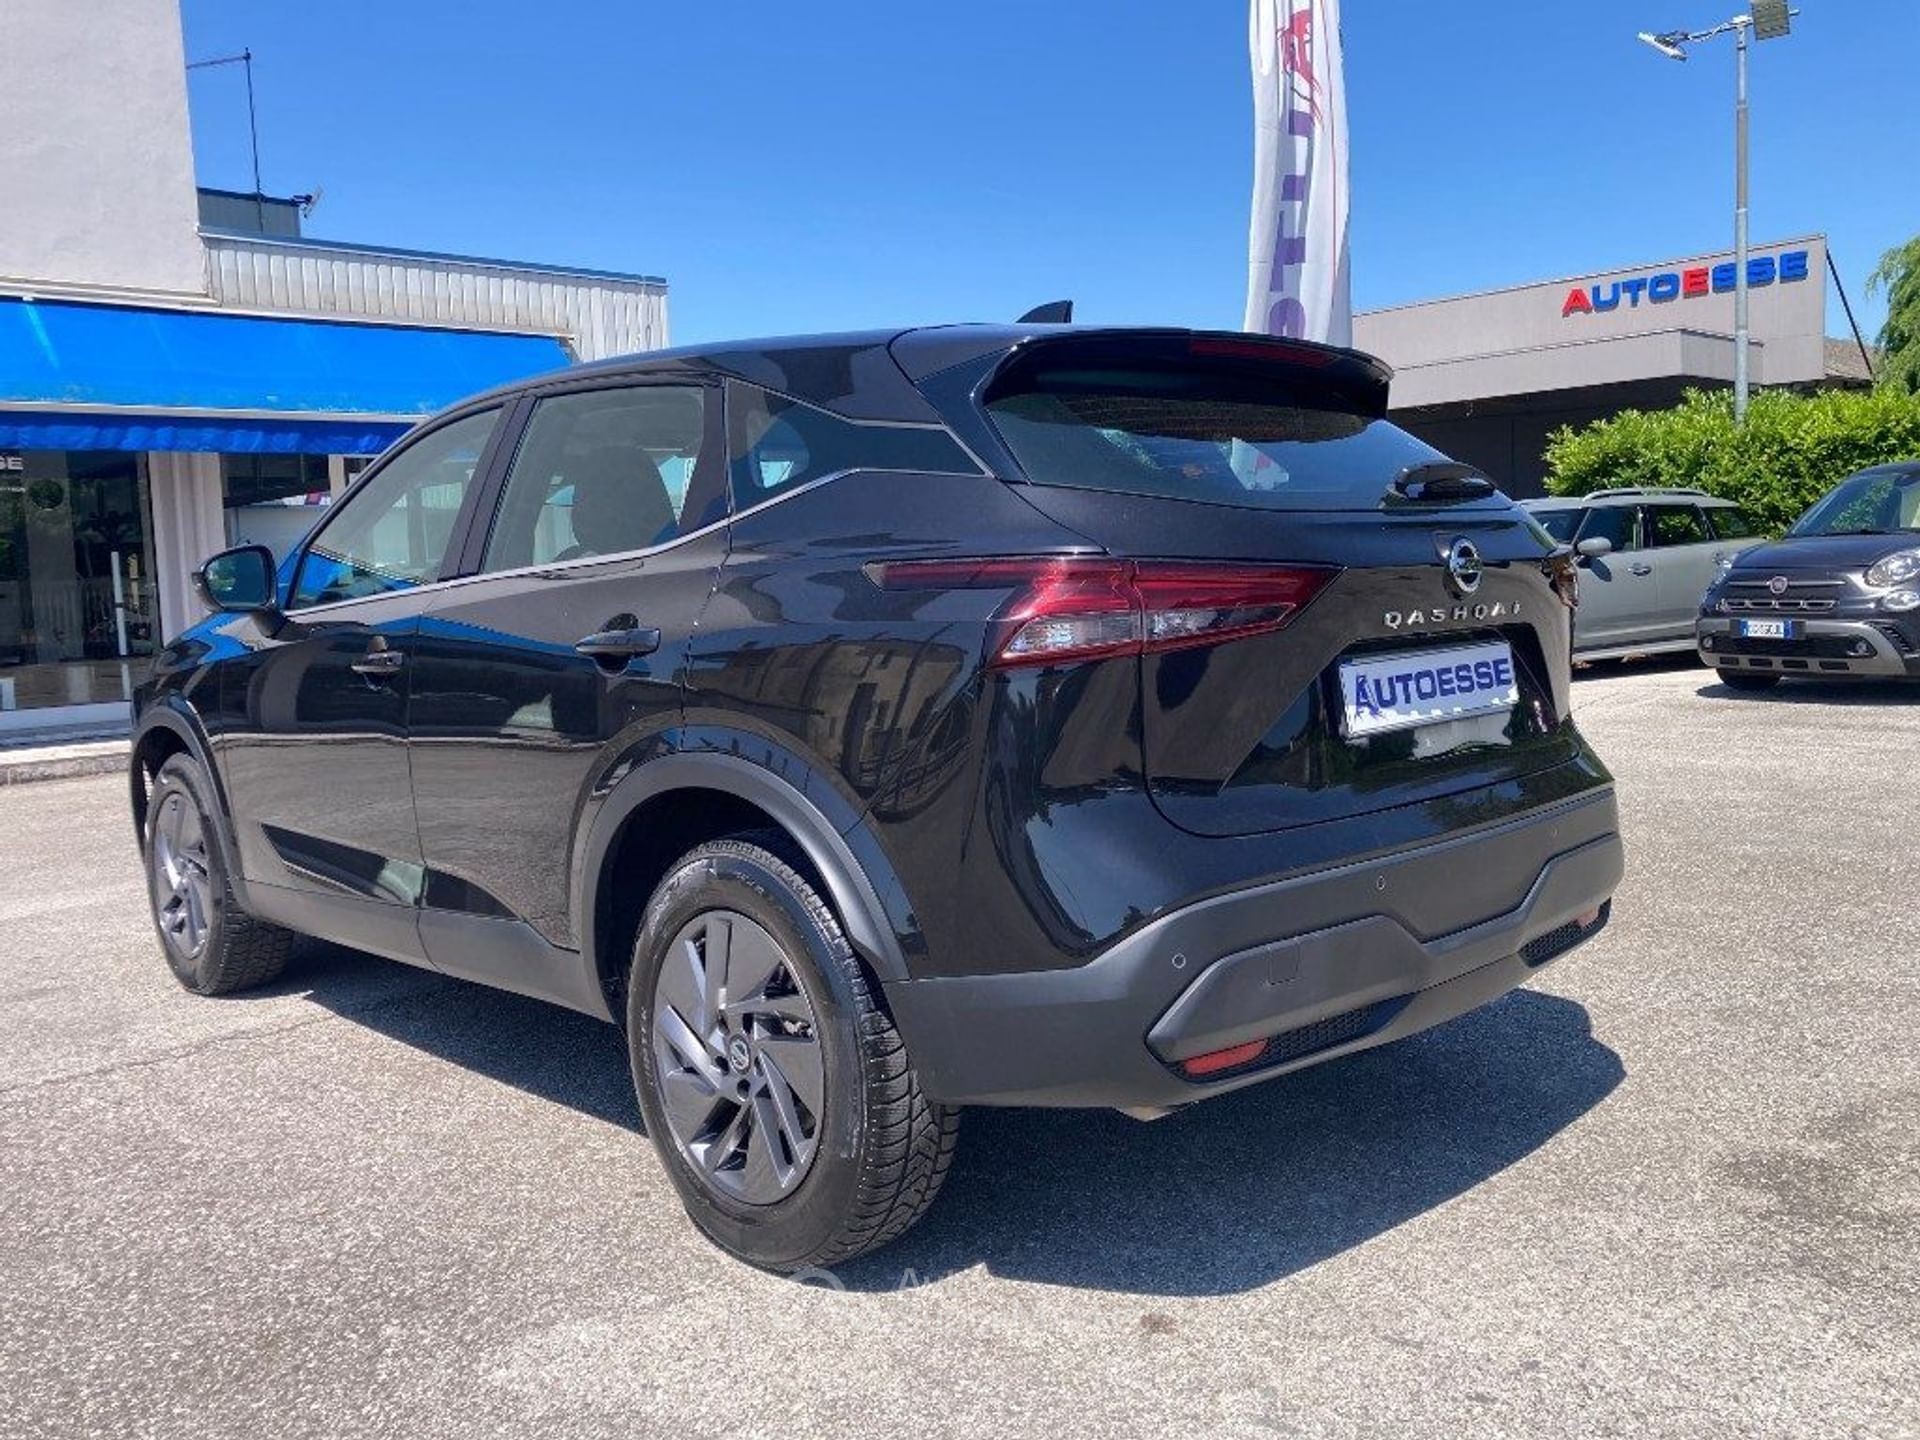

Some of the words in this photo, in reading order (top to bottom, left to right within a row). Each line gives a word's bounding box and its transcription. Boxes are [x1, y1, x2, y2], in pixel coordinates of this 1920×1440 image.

[1562, 251, 1808, 317] AUTOESSE
[1384, 600, 1521, 629] QASHQAI
[1355, 658, 1512, 718] AUTOESSE
